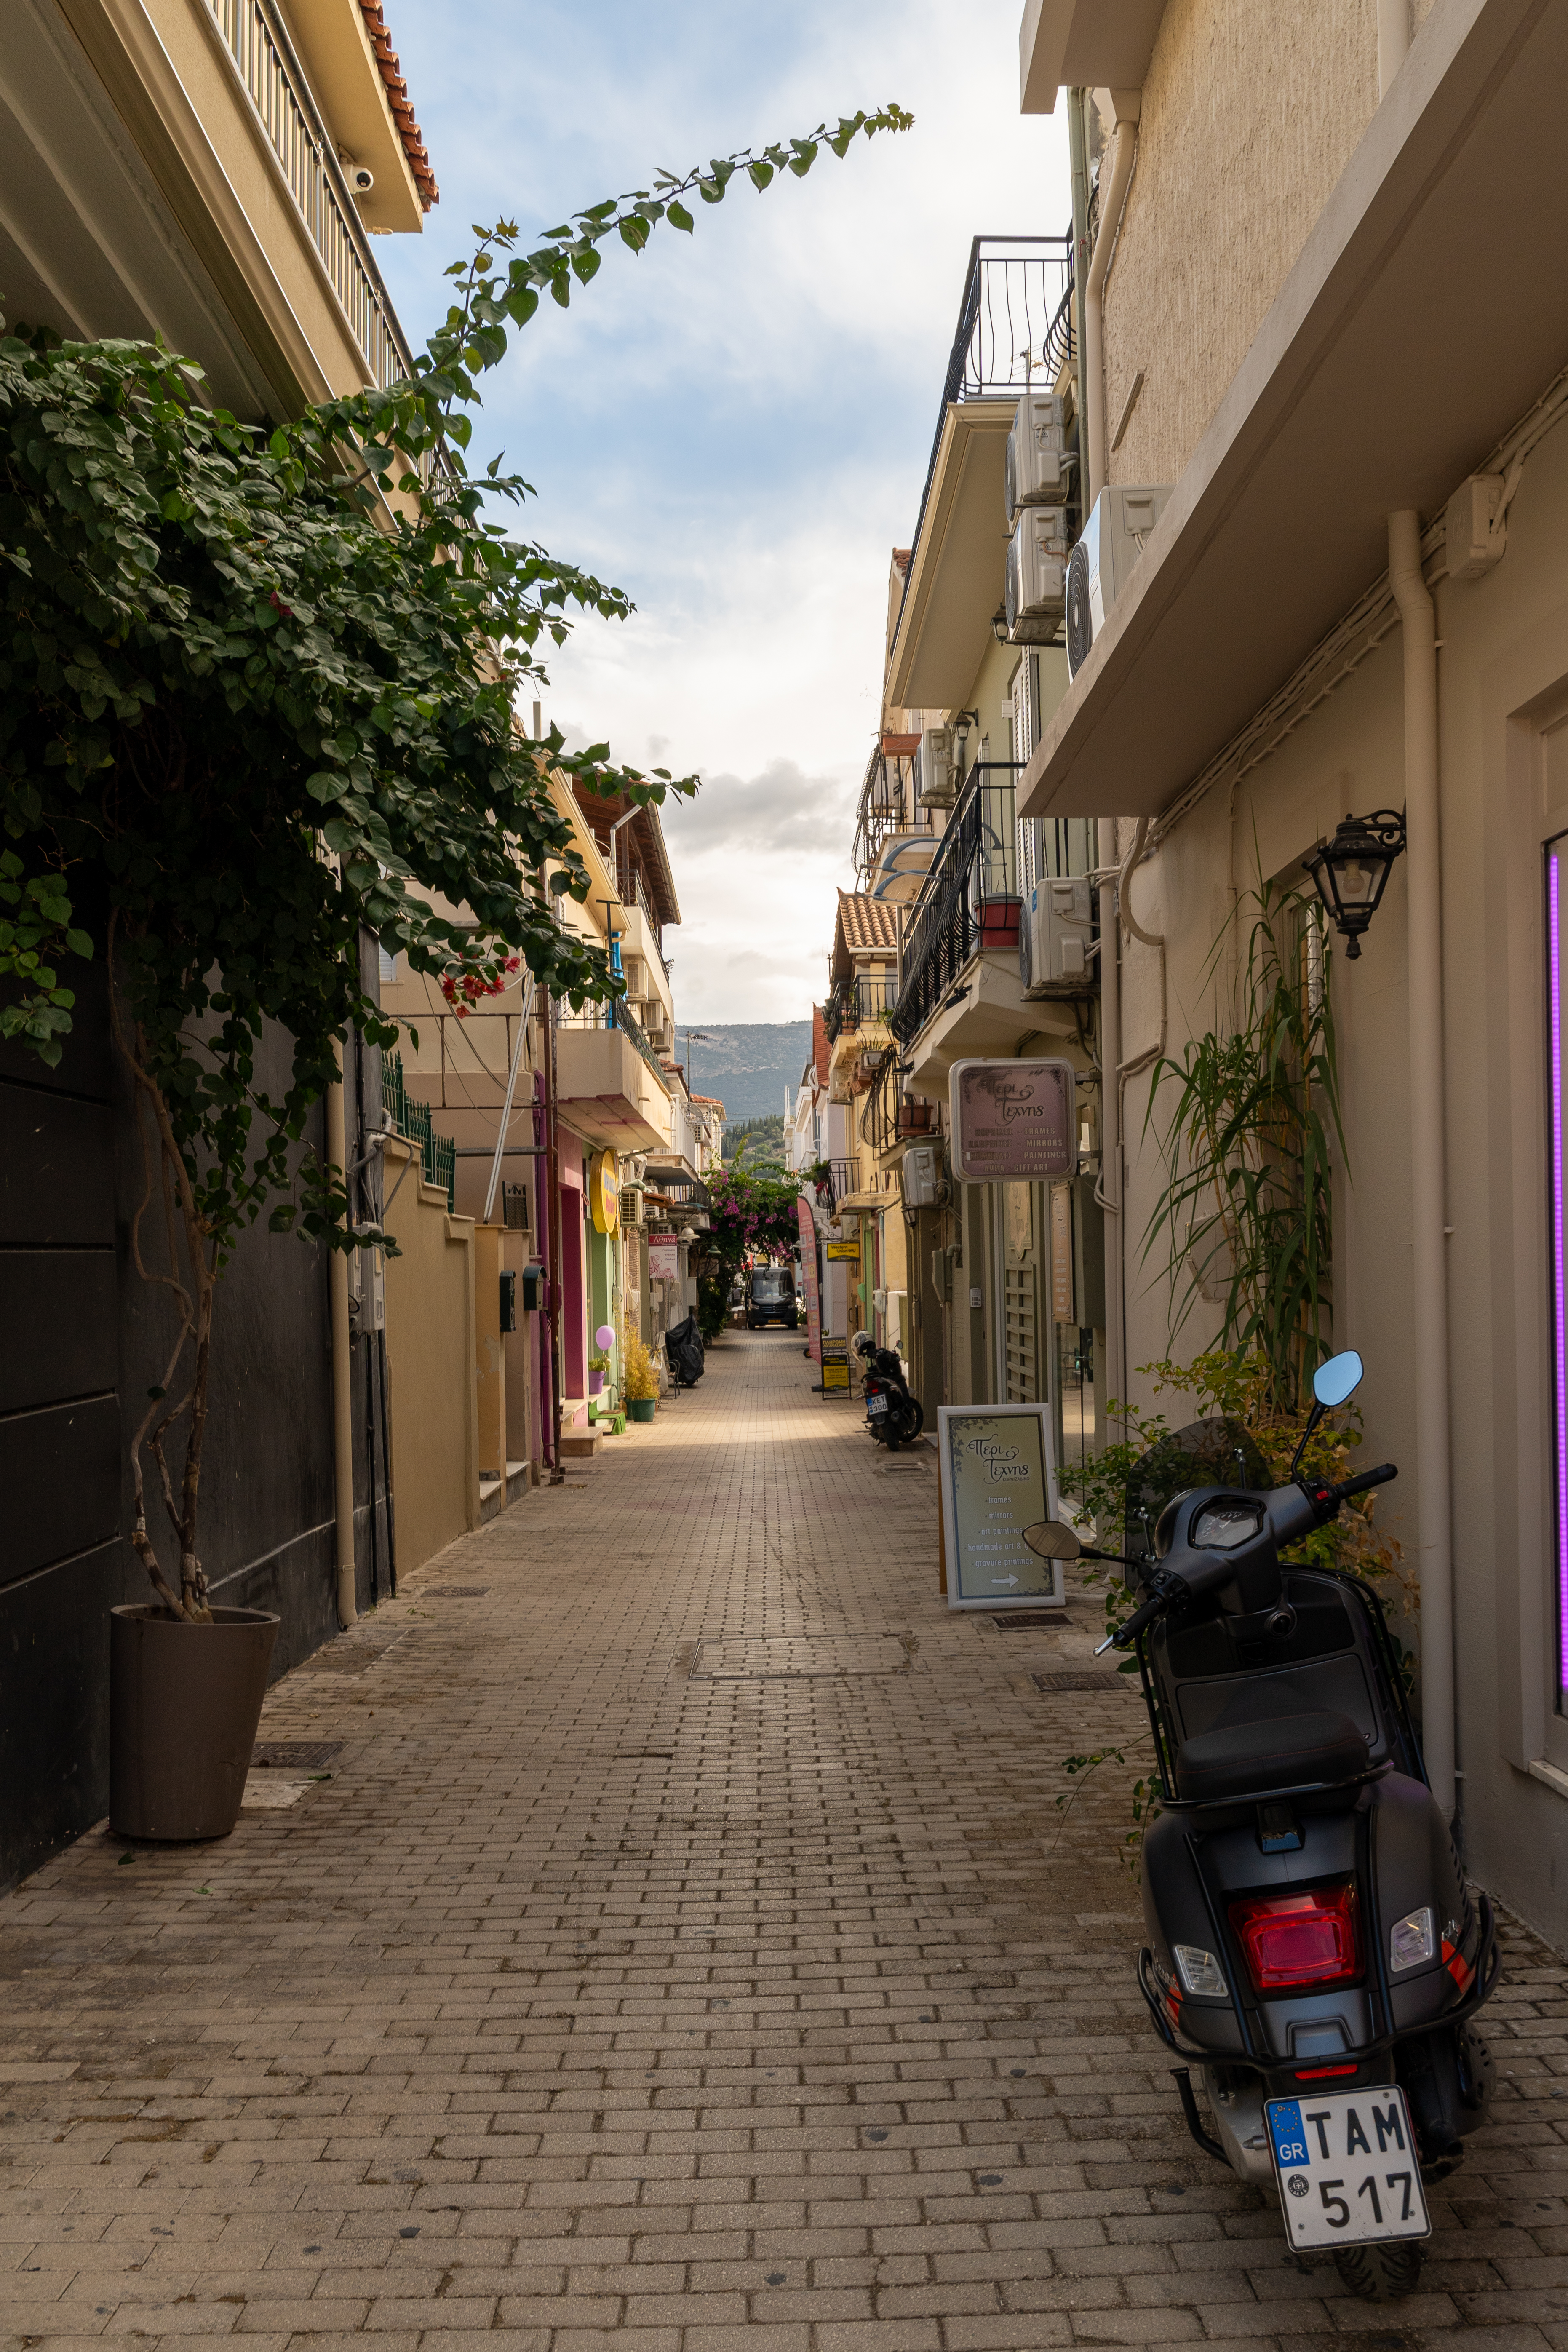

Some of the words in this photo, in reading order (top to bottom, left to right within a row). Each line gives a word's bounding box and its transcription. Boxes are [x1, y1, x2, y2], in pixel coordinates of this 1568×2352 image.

[1026, 1139, 1063, 1147] MIRRORS
[1024, 1151, 1066, 1159] PAINTINGS
[872, 1396, 884, 1405] KET
[873, 1403, 887, 1412] 300
[993, 1526, 1023, 1537] paintings
[1004, 1557, 1034, 1567] printings
[1280, 2142, 1305, 2160] GR
[1306, 2103, 1405, 2159] TAM
[1318, 2171, 1412, 2228] 517
